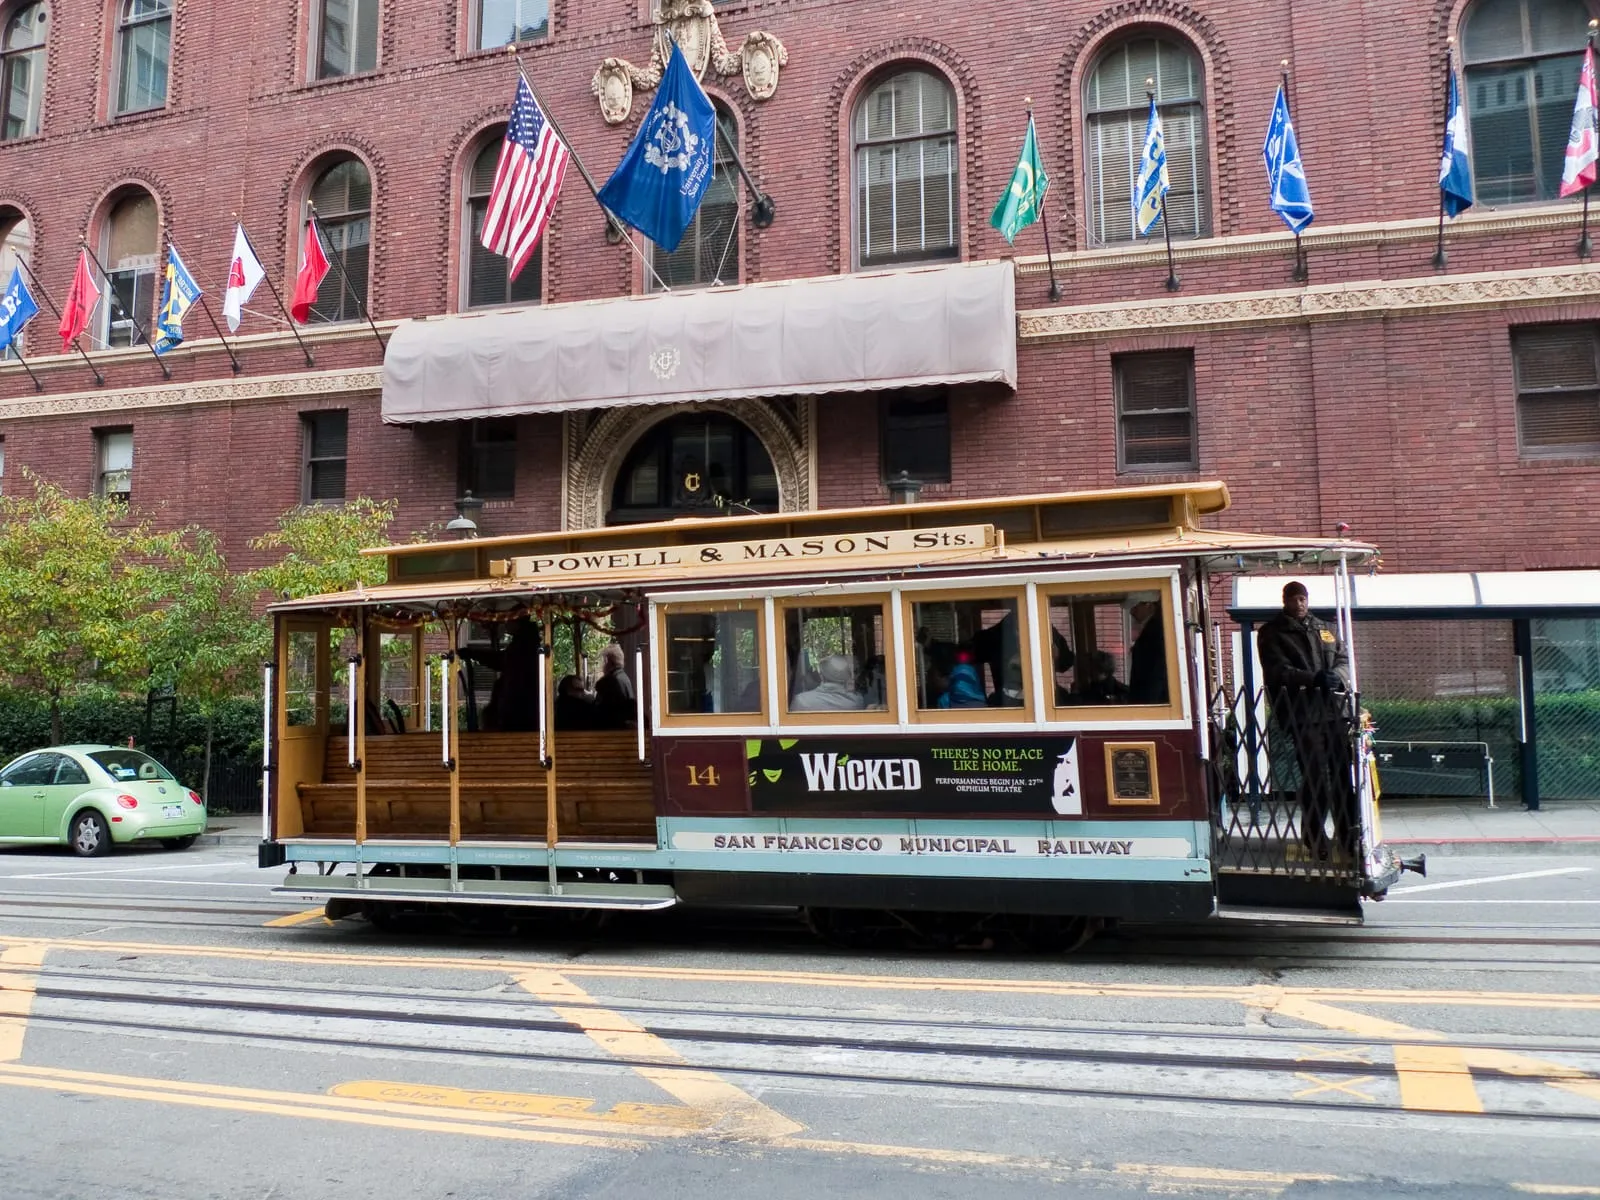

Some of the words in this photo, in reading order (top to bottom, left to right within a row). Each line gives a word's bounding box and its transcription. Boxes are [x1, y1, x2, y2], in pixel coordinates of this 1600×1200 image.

[532, 550, 681, 573] POWELL
[700, 547, 723, 562] &
[742, 535, 891, 560] MASON
[913, 530, 975, 549] Sts.
[931, 748, 980, 760] THERE'S
[982, 749, 1002, 760] NO
[1005, 749, 1044, 760] PLACE
[687, 764, 720, 787] 14
[953, 760, 979, 771] LIKE
[982, 760, 1022, 772] HOME.
[713, 834, 756, 850] SAN
[764, 834, 883, 852] FRANCISCO
[900, 837, 1016, 854] MUNICIPAL
[1037, 839, 1134, 856] RAILWAY
